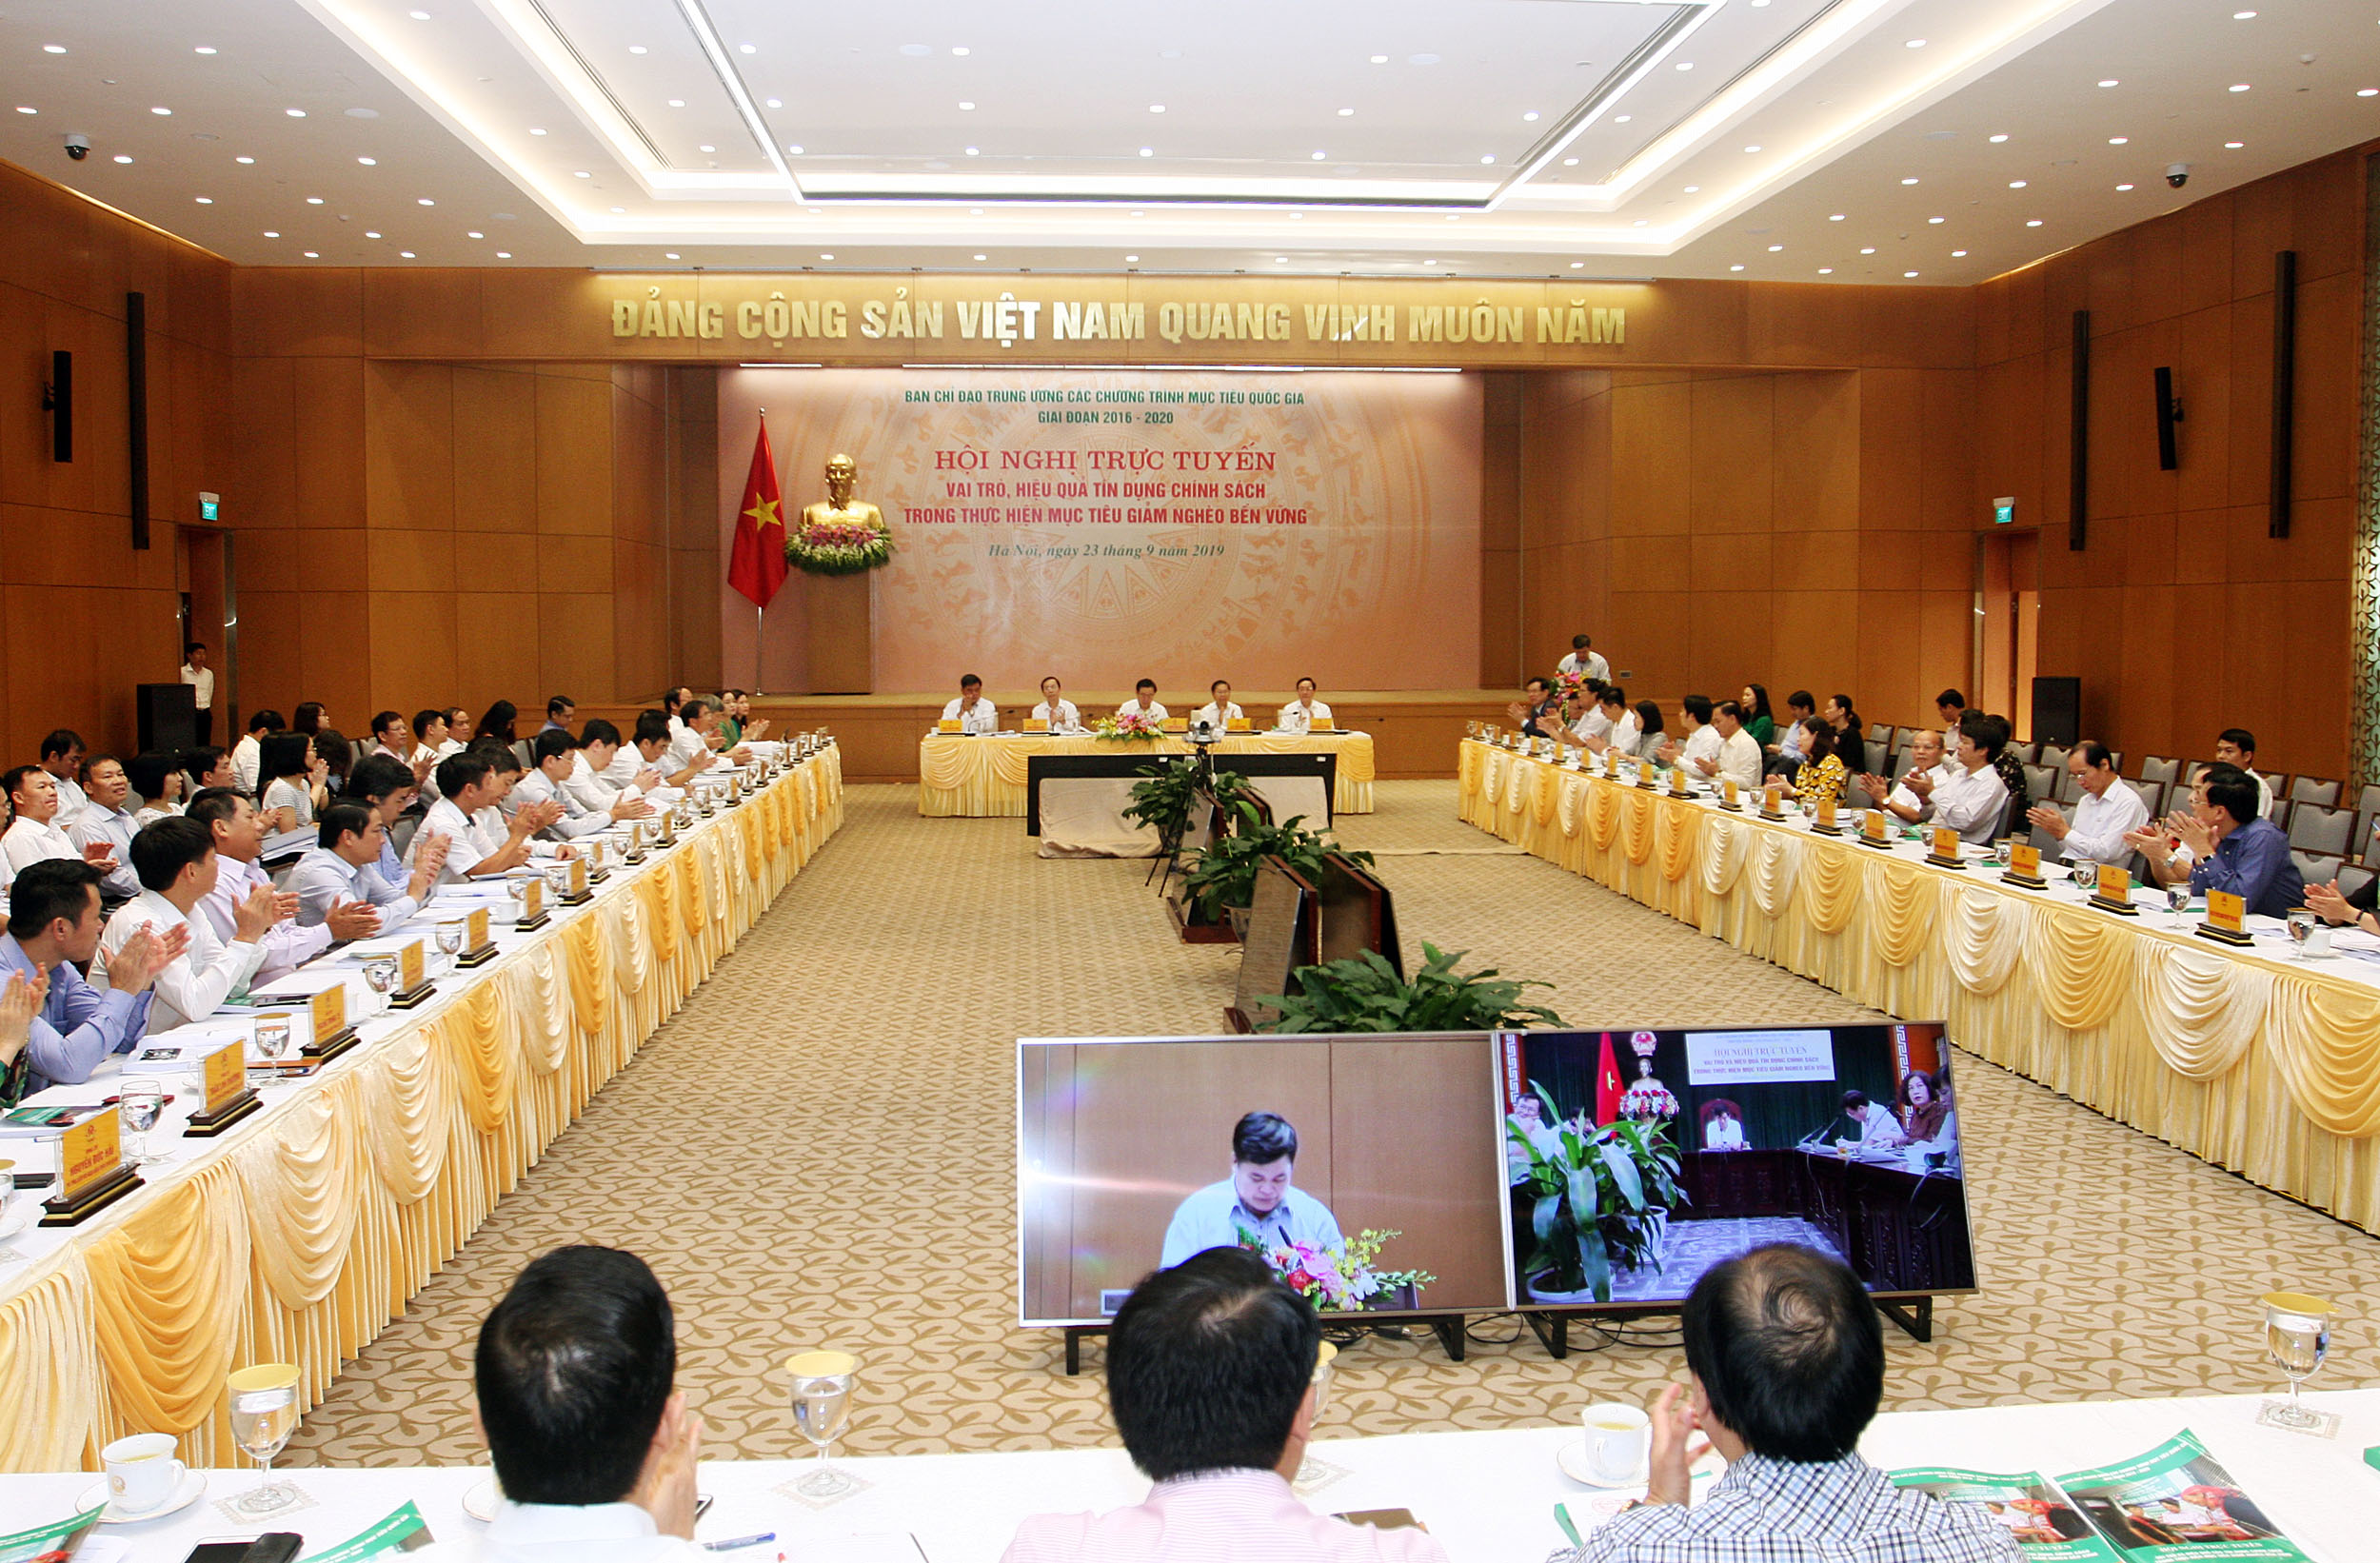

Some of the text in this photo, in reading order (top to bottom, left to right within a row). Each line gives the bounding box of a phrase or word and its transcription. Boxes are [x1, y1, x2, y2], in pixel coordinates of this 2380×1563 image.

[611, 287, 1626, 347] ĐẢNG CỘNG SẢN VIỆT NAM QUANG VINH MUÔN NĂM
[905, 390, 930, 403] BAN
[959, 390, 982, 406] ĐẠO
[987, 390, 1026, 403] TRUNG
[1030, 389, 1063, 403] ƯƠNG
[1067, 387, 1091, 403] CÁC
[1096, 389, 1144, 404] CHƯƠNG
[1149, 388, 1184, 404] TRÌNH
[1189, 391, 1215, 406] MỤC
[1220, 388, 1244, 405] TIÊU
[1285, 392, 1304, 405] GIA
[1038, 411, 1062, 424] GIAI
[1066, 411, 1099, 425] ĐOẠN
[1103, 411, 1132, 424] 2016
[1144, 412, 1174, 424] 2020
[934, 442, 1277, 475] HỘI NGHỊ TRỰC TUYẾN
[946, 483, 971, 498] VAI
[1016, 479, 1051, 501] HIỆU
[1057, 476, 1088, 499] QUẢ
[1093, 479, 1118, 498] TÍN
[1123, 483, 1166, 501] DỤNG
[1171, 480, 1219, 498] CHÍNH
[1224, 480, 1265, 499] SÁCH
[904, 508, 956, 524] TRONG
[961, 506, 1001, 526] THỰC
[1006, 505, 1042, 526] HIỆN
[1048, 507, 1083, 526] MỤC
[1088, 505, 1121, 524] TIÊU
[1127, 501, 1167, 524] GIẢM
[1173, 505, 1224, 524] NGHÈO
[1266, 505, 1307, 524] VỮNG
[1047, 544, 1079, 560] ngày
[1082, 544, 1099, 557] 23
[1103, 544, 1142, 560] tháng
[1146, 544, 1155, 557] 9
[1192, 544, 1225, 557] 2019
